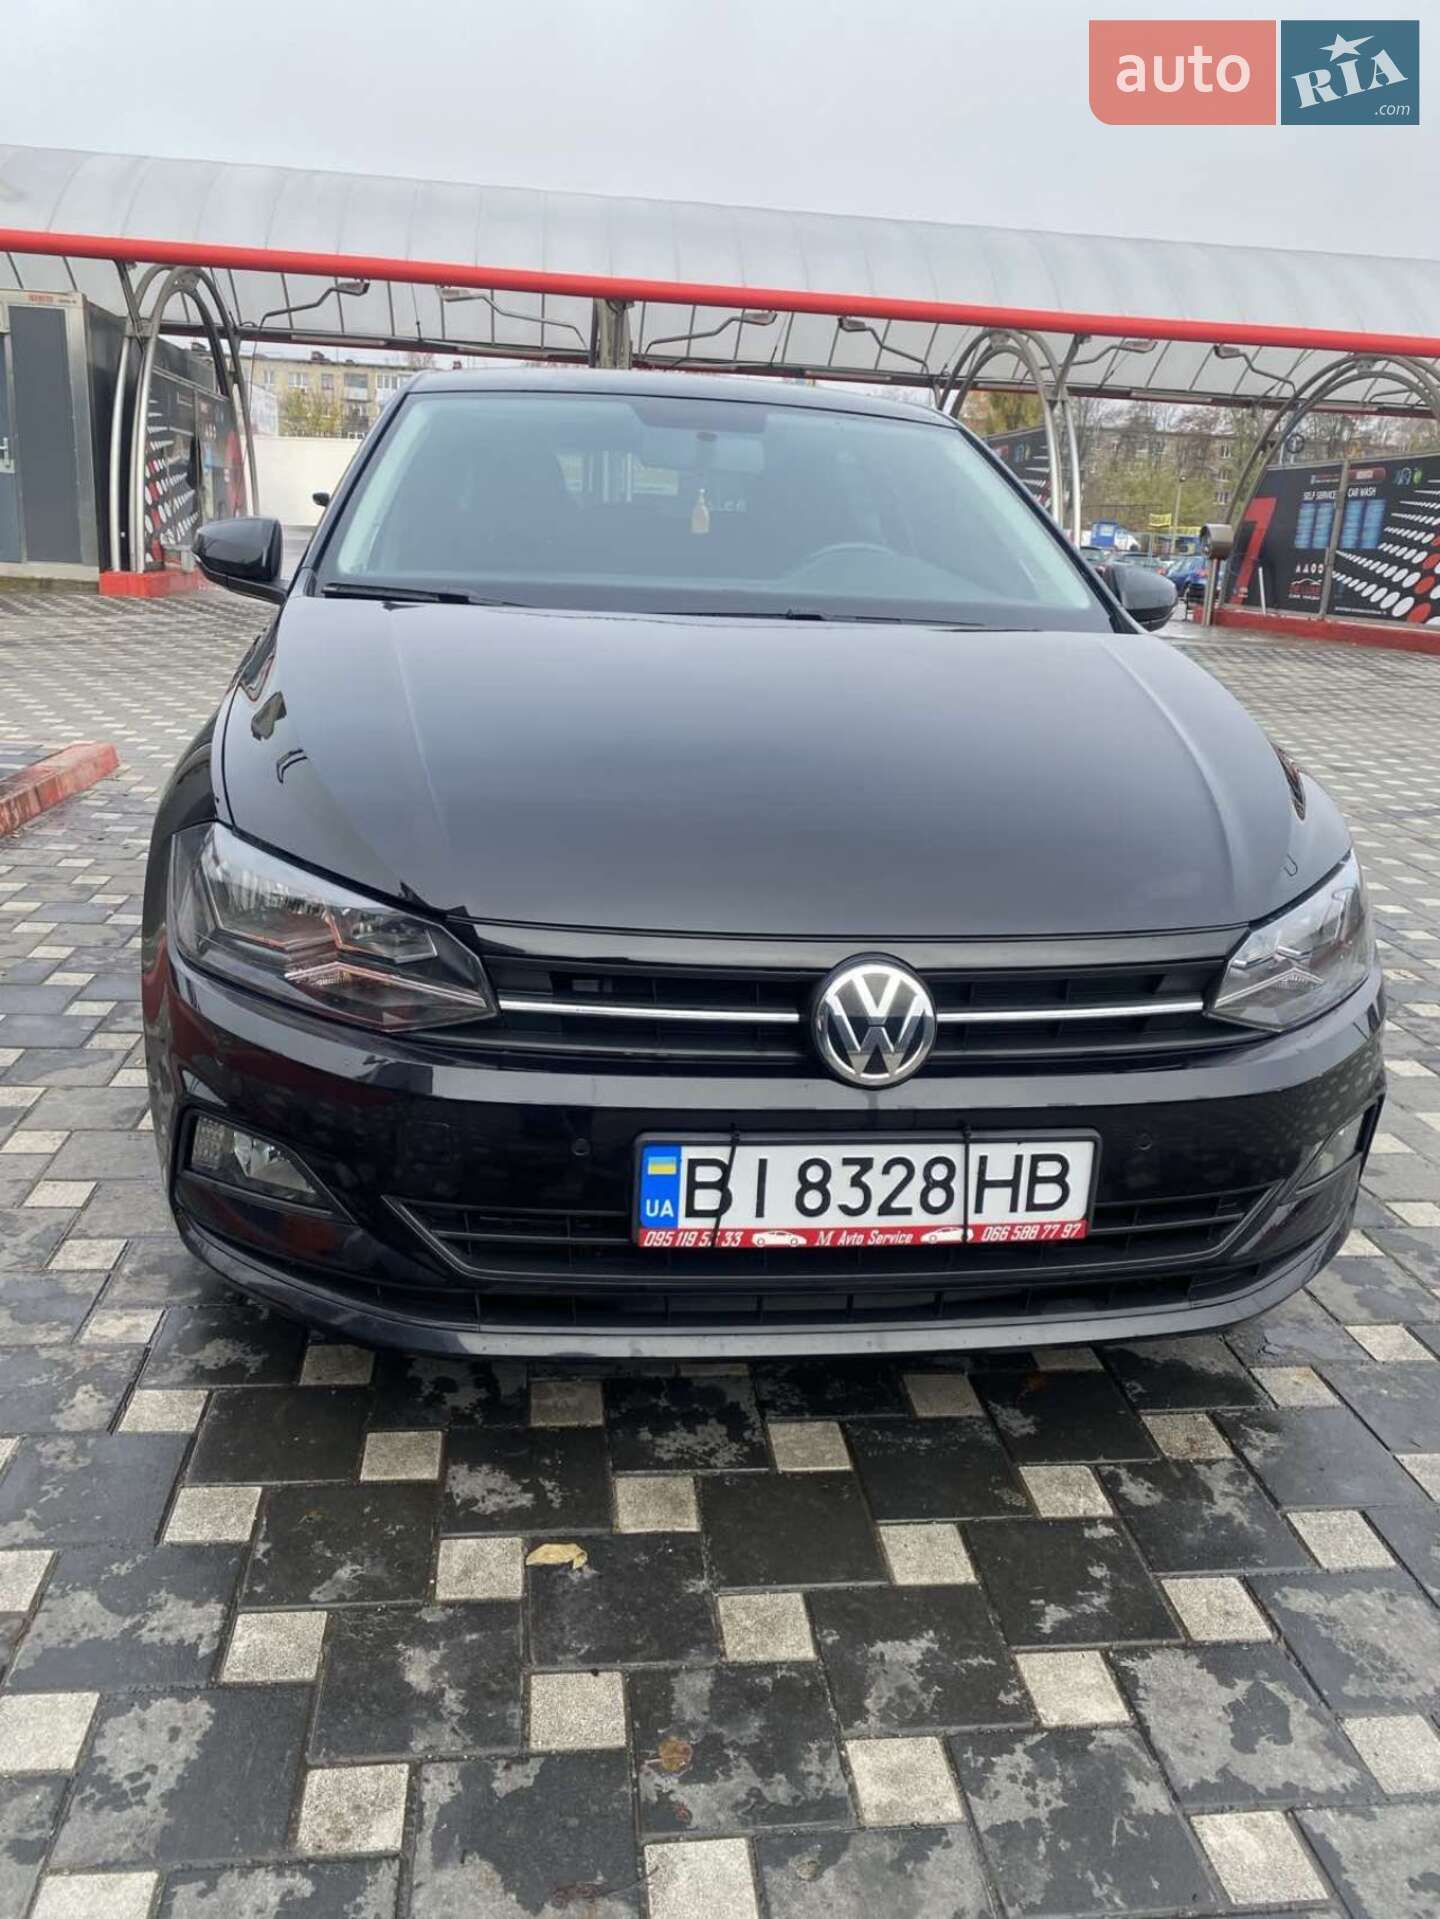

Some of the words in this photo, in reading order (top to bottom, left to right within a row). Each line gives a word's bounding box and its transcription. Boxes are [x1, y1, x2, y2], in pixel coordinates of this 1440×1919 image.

[795, 1156, 957, 1218] 8328
[974, 1153, 1070, 1214] HB
[645, 1199, 674, 1217] UA
[643, 1231, 675, 1247] 095
[675, 1231, 698, 1247] 119
[721, 1231, 744, 1247] 33
[815, 1229, 835, 1246] M
[836, 1229, 866, 1246] Avto
[867, 1229, 915, 1246] Service
[981, 1226, 1011, 1242] 066
[1010, 1225, 1040, 1241] 588
[1041, 1224, 1060, 1240] 77
[1061, 1223, 1082, 1239] 97
